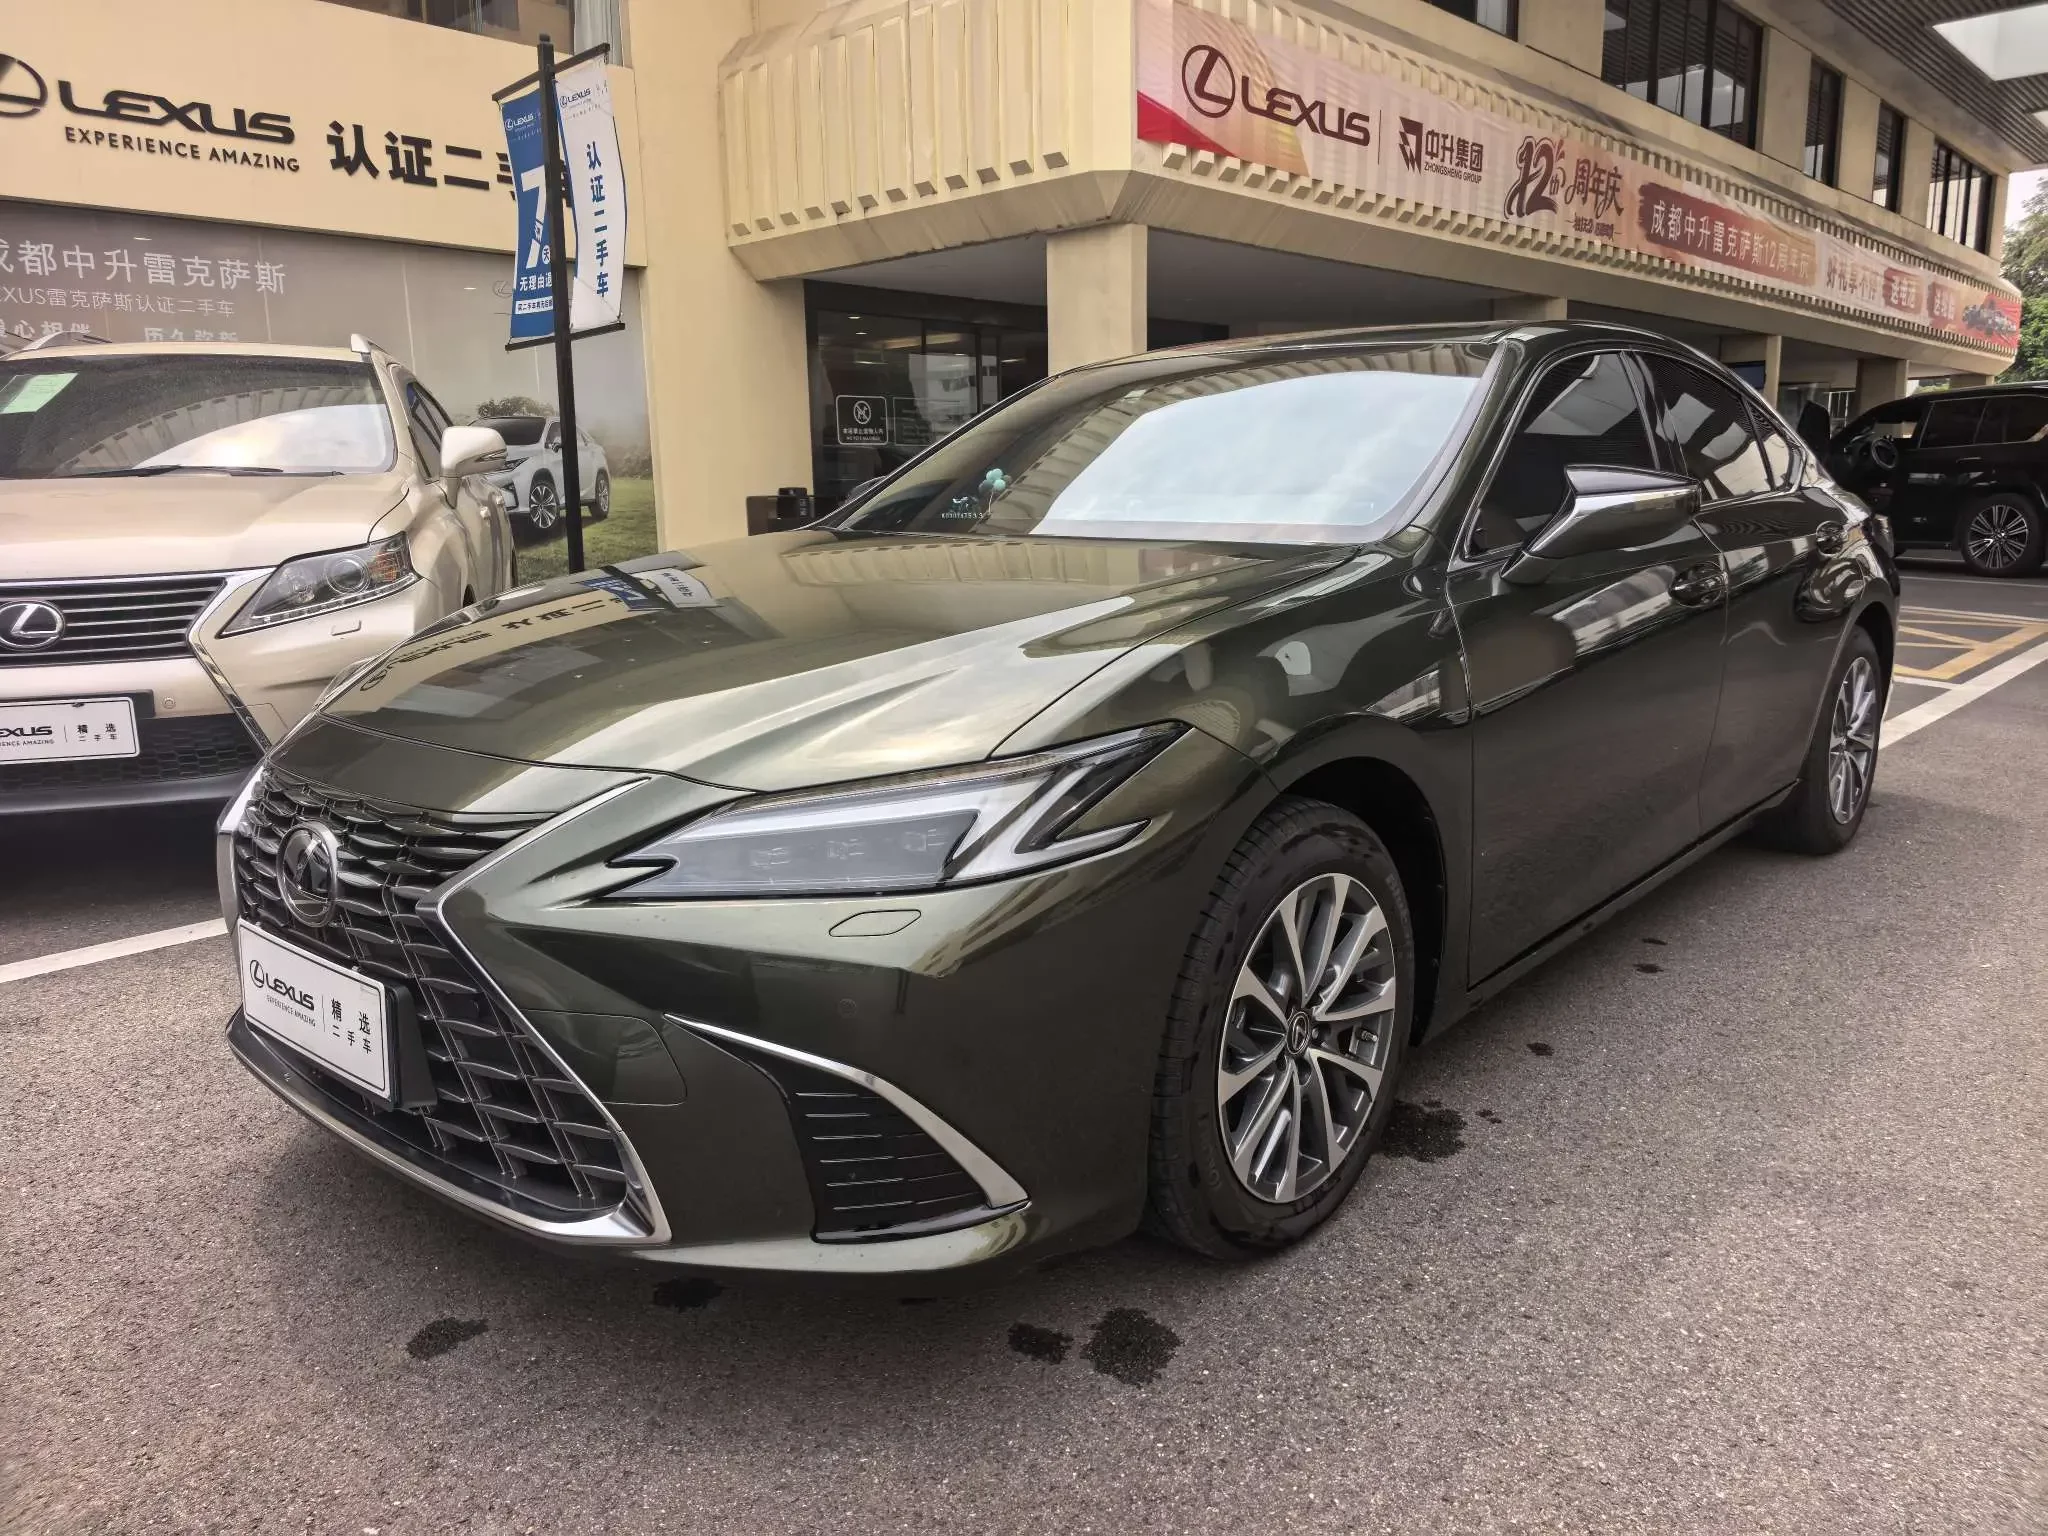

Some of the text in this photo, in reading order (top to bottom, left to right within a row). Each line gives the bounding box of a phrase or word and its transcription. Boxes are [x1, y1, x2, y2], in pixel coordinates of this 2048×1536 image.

[57, 80, 296, 145] LEXUS
[567, 88, 591, 103] LEXUS
[1241, 75, 1371, 147] LEXUS
[514, 113, 534, 126] LEXUS
[65, 126, 300, 173] EXPERIENCE AMAZING
[1425, 129, 1484, 173] 中升集团
[1424, 161, 1483, 185] ZHONGSHENG GROUP
[586, 140, 609, 298] 认证二手车
[265, 972, 315, 1012] LEXUS
[266, 994, 316, 1028] EXPERIENCE AMAZING
[330, 997, 372, 1037] 精选
[332, 1024, 373, 1055] 二手车
